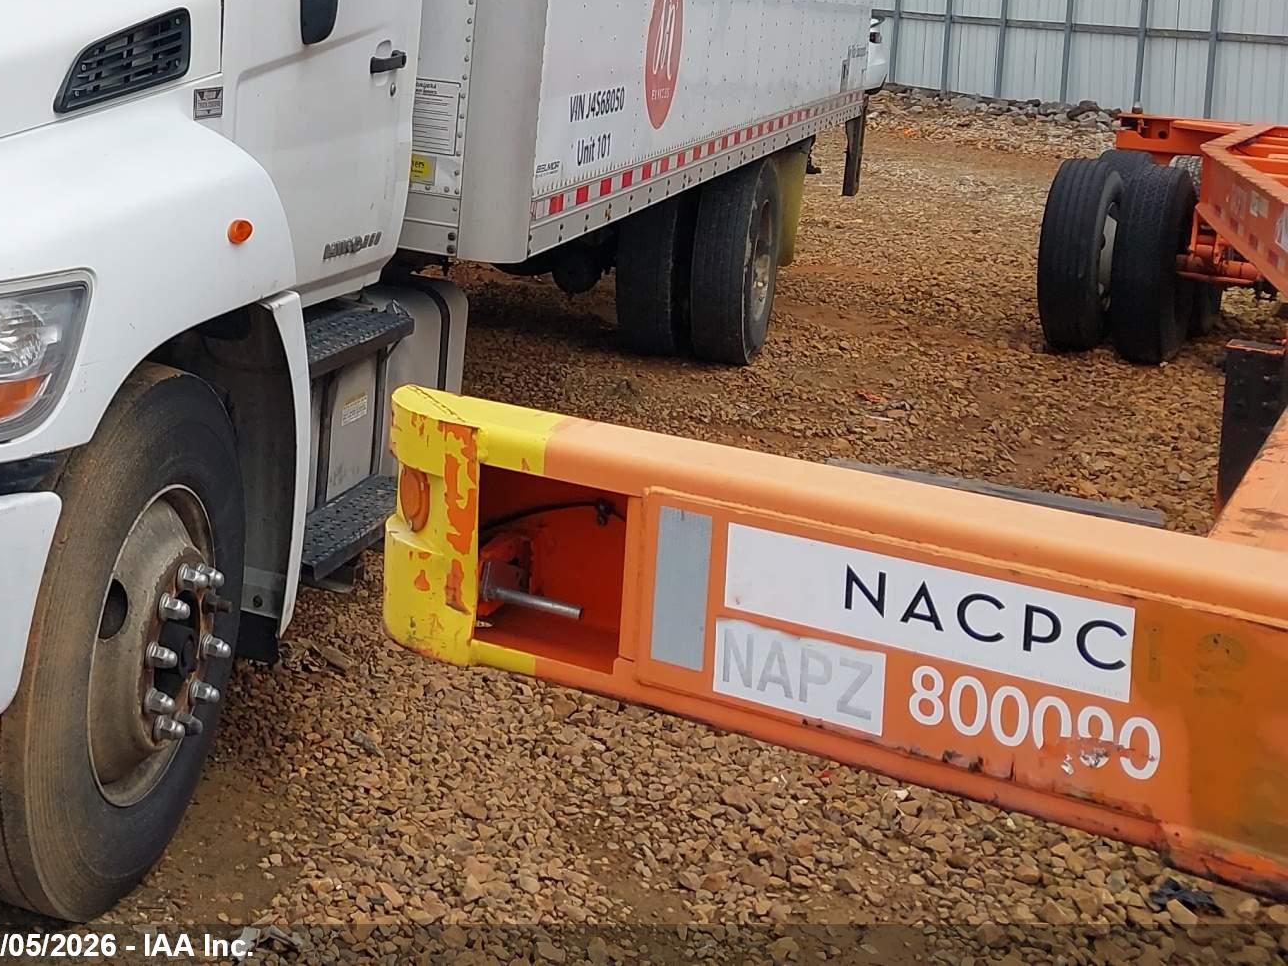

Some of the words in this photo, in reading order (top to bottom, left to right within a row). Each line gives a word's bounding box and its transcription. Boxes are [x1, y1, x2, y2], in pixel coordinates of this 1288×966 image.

[570, 94, 585, 122] VIN
[577, 136, 595, 166] Unit
[597, 133, 611, 159] 101
[844, 563, 1128, 671] NACPC
[722, 628, 874, 721] NAPZ
